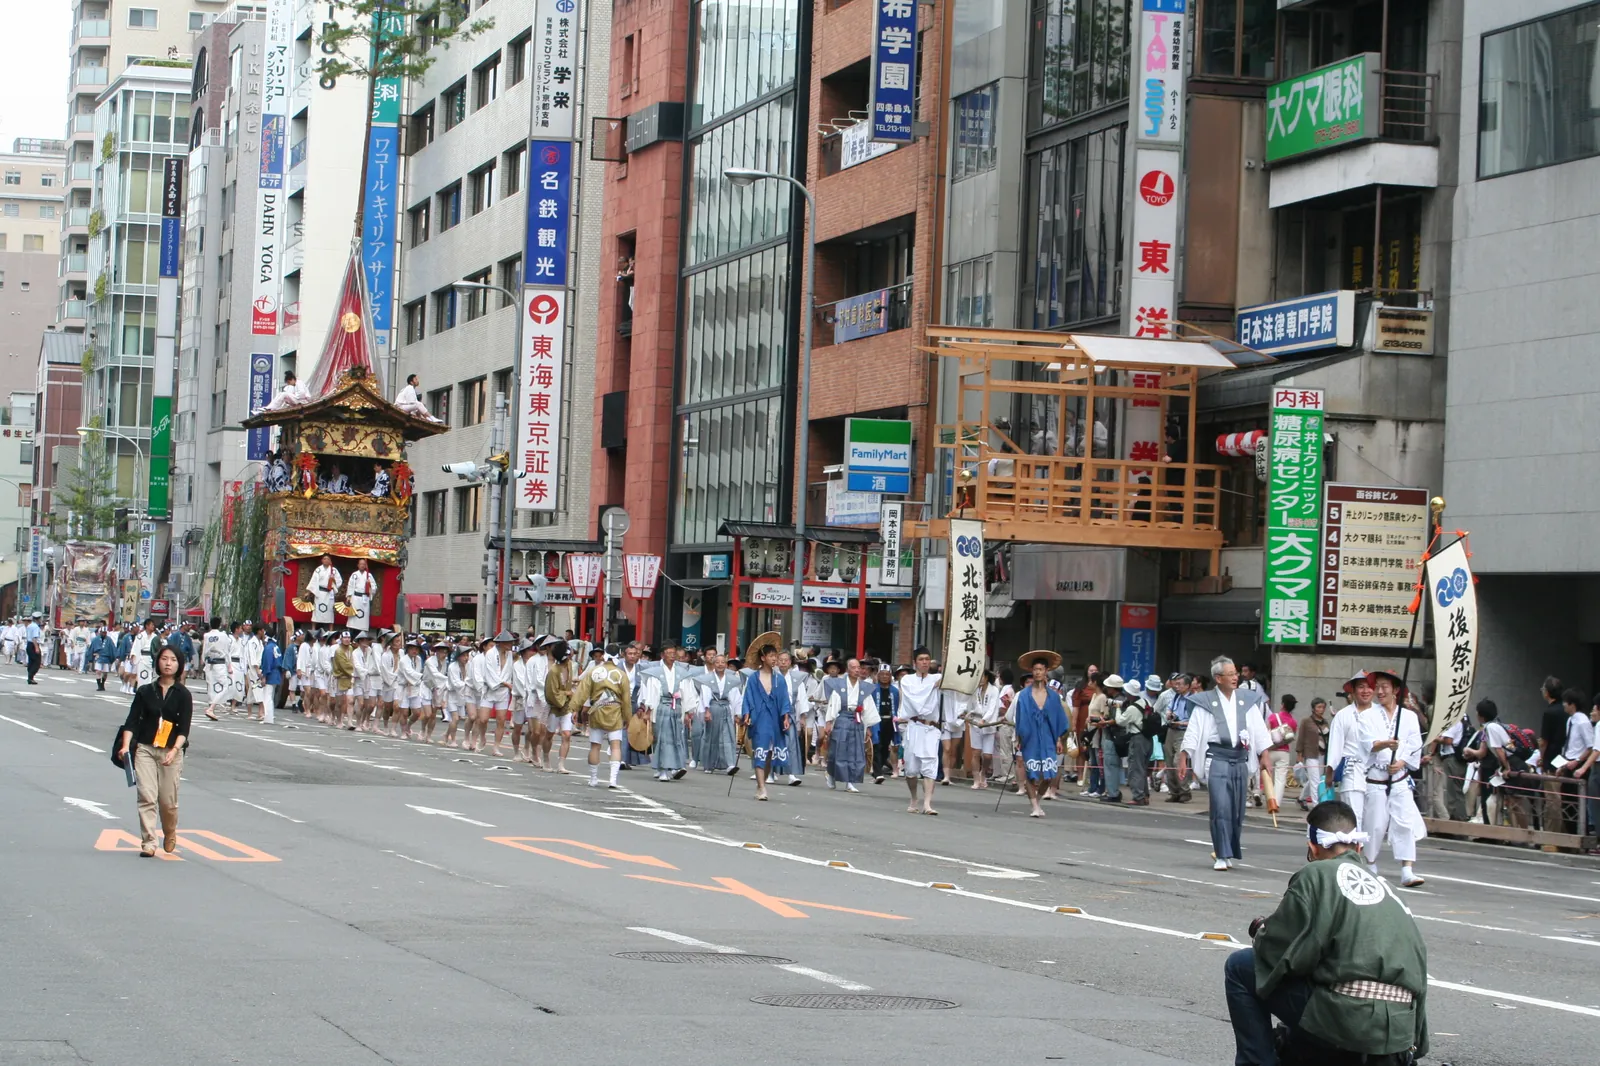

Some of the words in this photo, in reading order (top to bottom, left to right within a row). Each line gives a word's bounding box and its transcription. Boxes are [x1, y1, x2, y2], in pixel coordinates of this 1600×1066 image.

[558, 18, 570, 59] 株式会社
[880, 0, 913, 91] 希学園
[1171, 20, 1181, 71] 成基幼児教室
[244, 44, 260, 153] JK四条ビル
[266, 51, 276, 111] ダンスシアター
[553, 66, 572, 109] 学栄
[1267, 61, 1363, 142] 大クマ眼科
[876, 102, 912, 115] 四条烏丸
[884, 113, 902, 125] 教室
[371, 138, 390, 193] ワコール
[262, 194, 276, 236] DAHN
[1146, 196, 1167, 204] TOYO
[369, 195, 389, 258] キャリア
[536, 171, 559, 277] 名鉄観光
[260, 244, 273, 283] YOGA
[368, 260, 386, 321] サービス
[1241, 303, 1333, 346] 日本法律専門学院
[524, 335, 554, 504] 東海東京証券
[1275, 390, 1320, 408] 内科
[851, 448, 908, 462] FamilyMart
[1272, 415, 1302, 526] 糖尿病センター
[1301, 432, 1318, 515] 井上クリニック
[871, 475, 887, 492] 酒
[1329, 507, 1339, 520] 5
[886, 509, 898, 578] 岡本会計事務所
[1328, 530, 1339, 543] 4
[1344, 532, 1383, 545] 大クマ眼科
[1327, 553, 1337, 566] 3
[1343, 556, 1404, 569] 日本法律専門学院
[820, 597, 845, 605] SSJ
[1267, 532, 1313, 643] 大クマ眼科
[1326, 577, 1336, 590] 2
[1327, 601, 1334, 613] 1
[1341, 603, 1415, 616] カネタ織物株式会
[1322, 624, 1336, 637] B1
